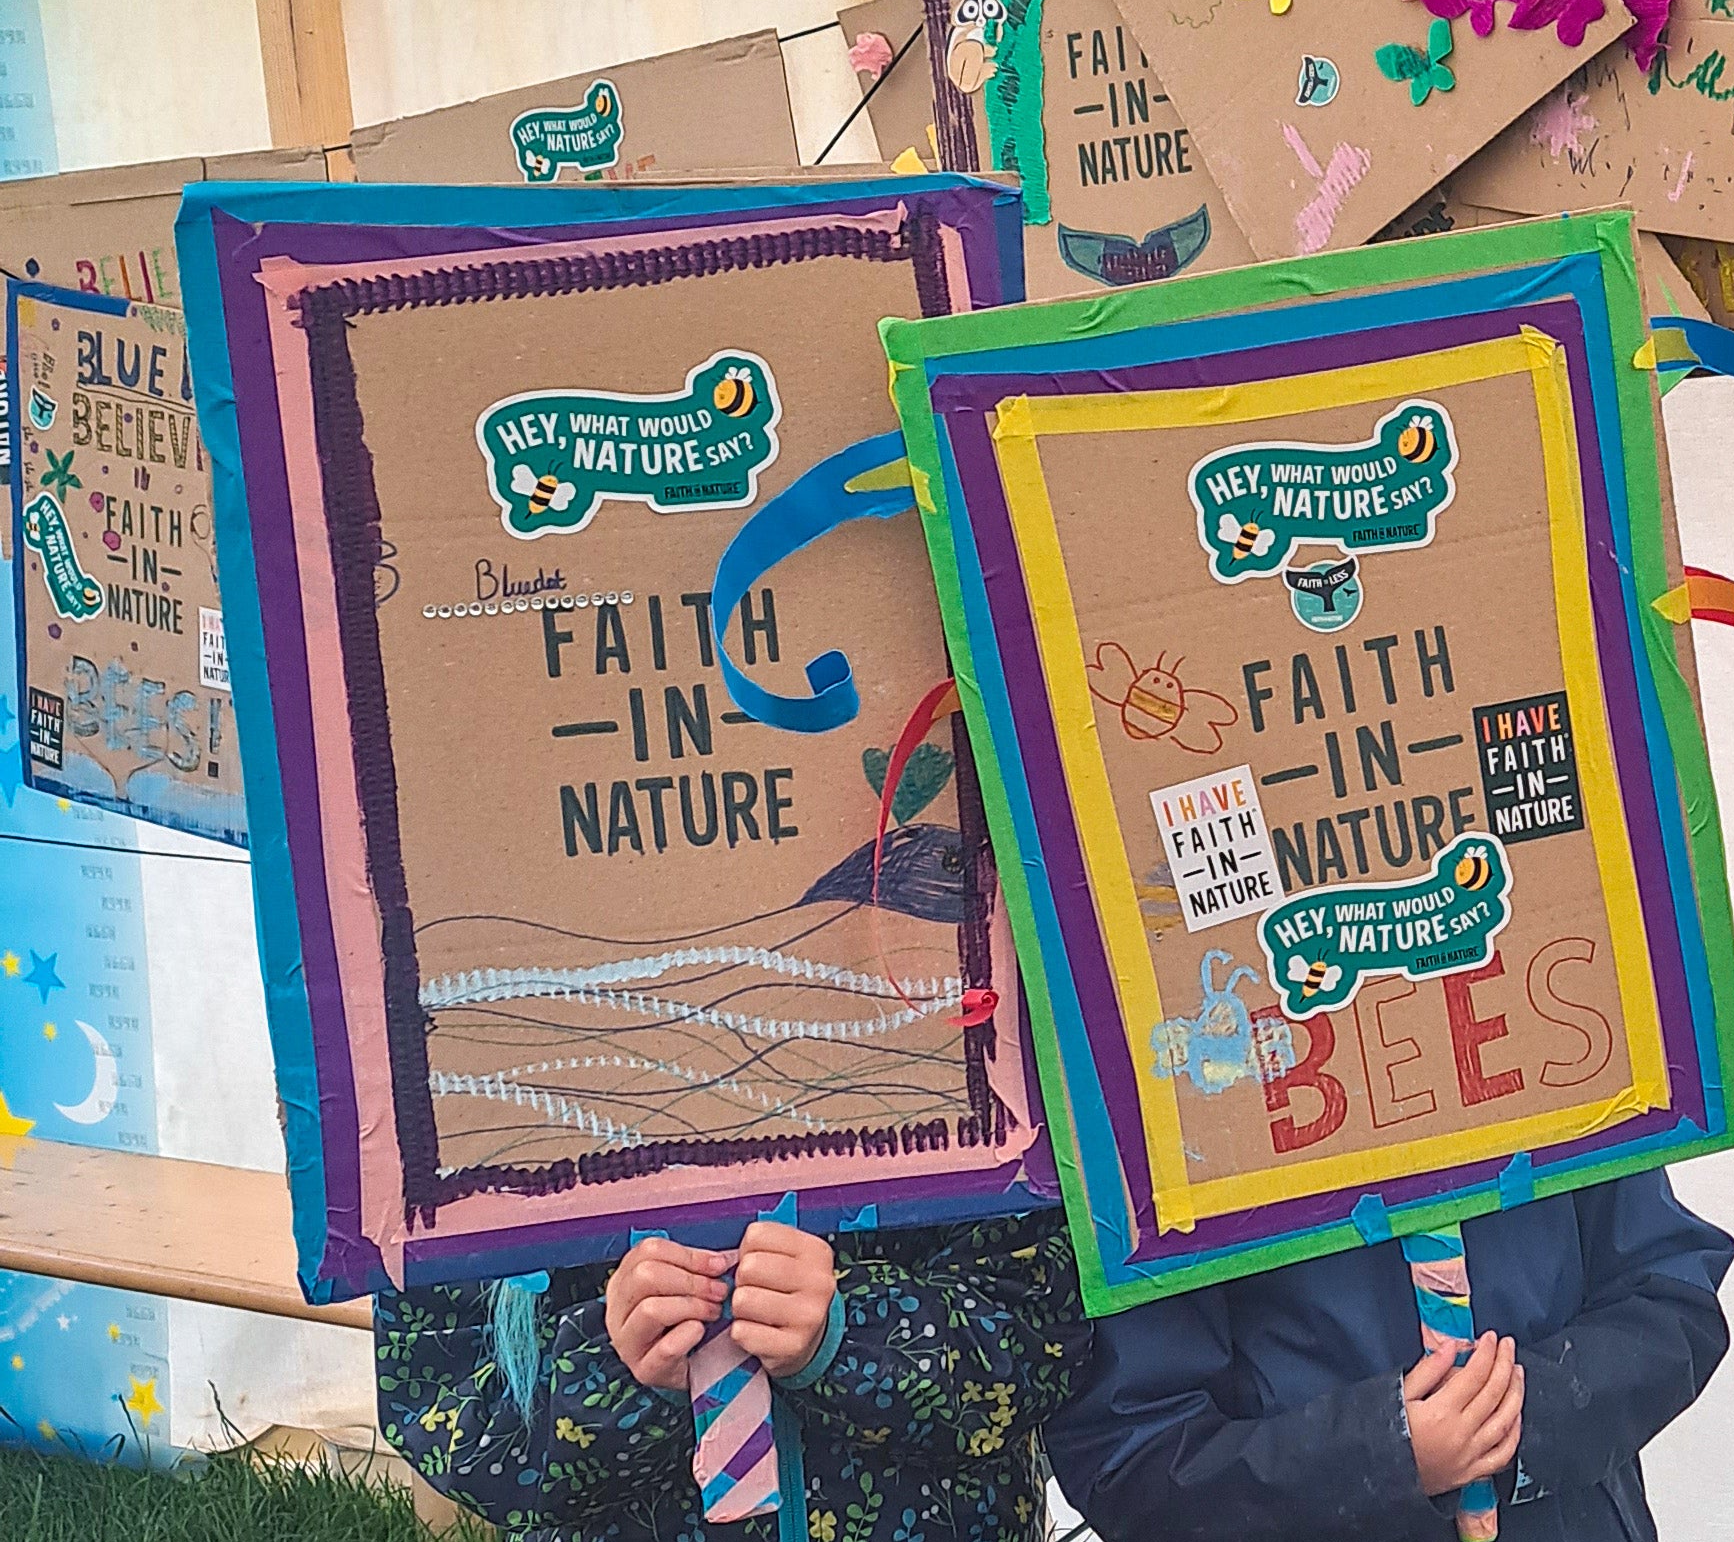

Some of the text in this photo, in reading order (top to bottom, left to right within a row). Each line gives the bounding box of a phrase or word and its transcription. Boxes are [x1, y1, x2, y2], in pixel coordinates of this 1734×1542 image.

[1067, 25, 1149, 79] FAI
[517, 113, 598, 146] HEY, WHAT WOULD
[547, 123, 616, 153] NATURE SAY?
[1078, 129, 1193, 187] NATURE
[76, 247, 177, 304] BELIE
[78, 330, 168, 398] BLUE
[72, 393, 204, 471] BELIEV
[496, 408, 713, 455] HEY, WHAT WOULD
[573, 431, 755, 475] NATURE SAY?
[1206, 456, 1397, 506] HEY, WHAT WOULD
[1272, 476, 1434, 521] NATURE SAY?
[105, 496, 183, 548] FAITH
[1353, 528, 1378, 542] FAITH
[1385, 523, 1421, 538] NATURE
[45, 533, 72, 592] NATURE
[1297, 577, 1323, 589] FAITH
[1328, 569, 1349, 586] LESS
[107, 583, 184, 636] NATURE
[541, 588, 780, 678] FAITH
[1241, 624, 1456, 734] FAITH
[1481, 702, 1562, 744] I HAVE
[1486, 733, 1567, 775] FAITH
[559, 767, 799, 857] NATURE
[1161, 778, 1249, 828] I HAVE
[1495, 795, 1576, 835] NATURE
[1170, 809, 1257, 859] FAITH
[1271, 786, 1477, 892] NATURE
[1188, 870, 1275, 919] NATURE
[1273, 886, 1456, 950] HEY, WHAT WOULD
[1338, 900, 1492, 954] NATURE SAY?
[1251, 937, 1614, 1155] BEES
